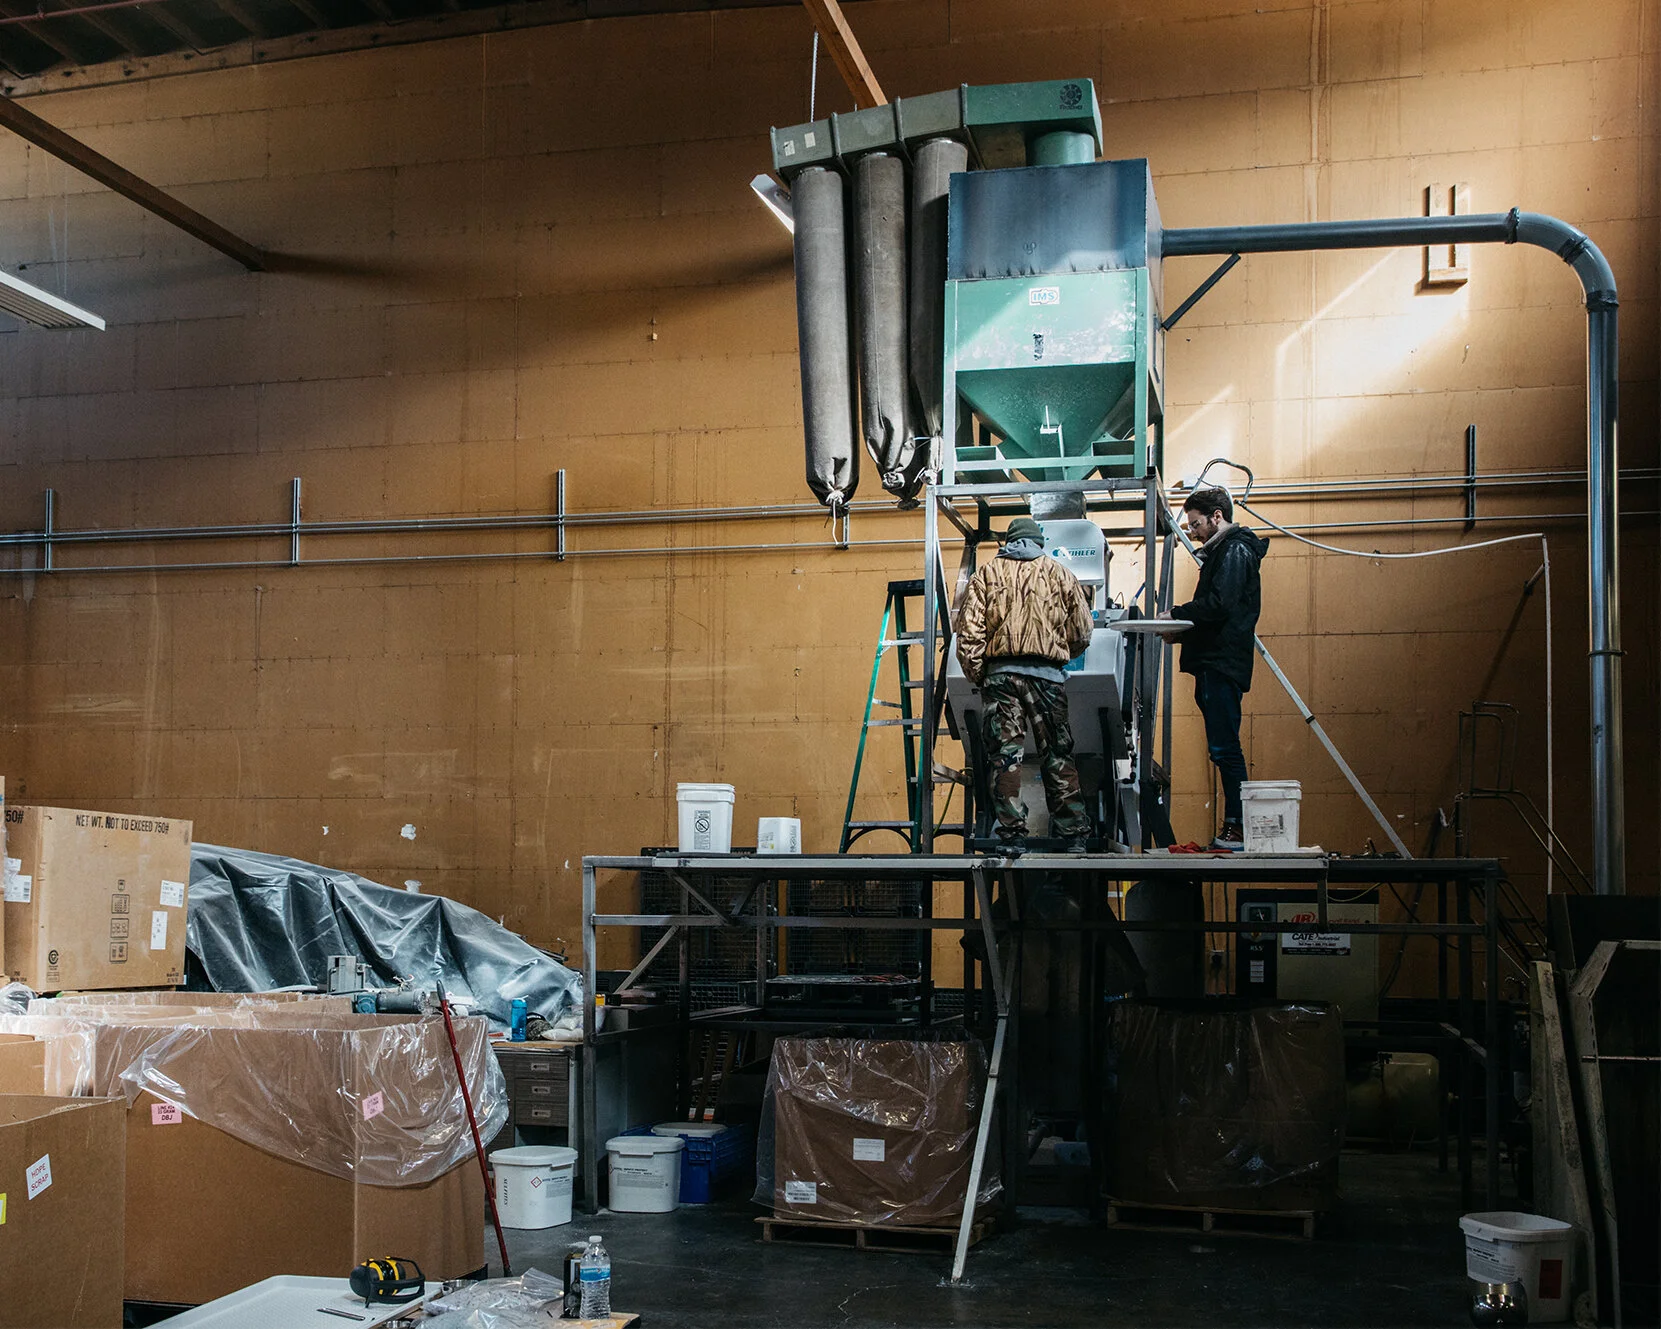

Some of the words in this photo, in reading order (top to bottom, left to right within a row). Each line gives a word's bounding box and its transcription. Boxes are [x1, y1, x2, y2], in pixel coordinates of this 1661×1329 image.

[1033, 292, 1055, 301] IMS
[4, 809, 24, 824] 50#
[75, 814, 89, 827] NET
[91, 816, 104, 828] WT.
[105, 816, 119, 829] NOT
[121, 818, 129, 830] TO
[130, 819, 153, 832] EXCEED
[154, 821, 169, 834] 750#
[1292, 933, 1314, 941] CATE
[31, 1173, 49, 1191] SCRAP
